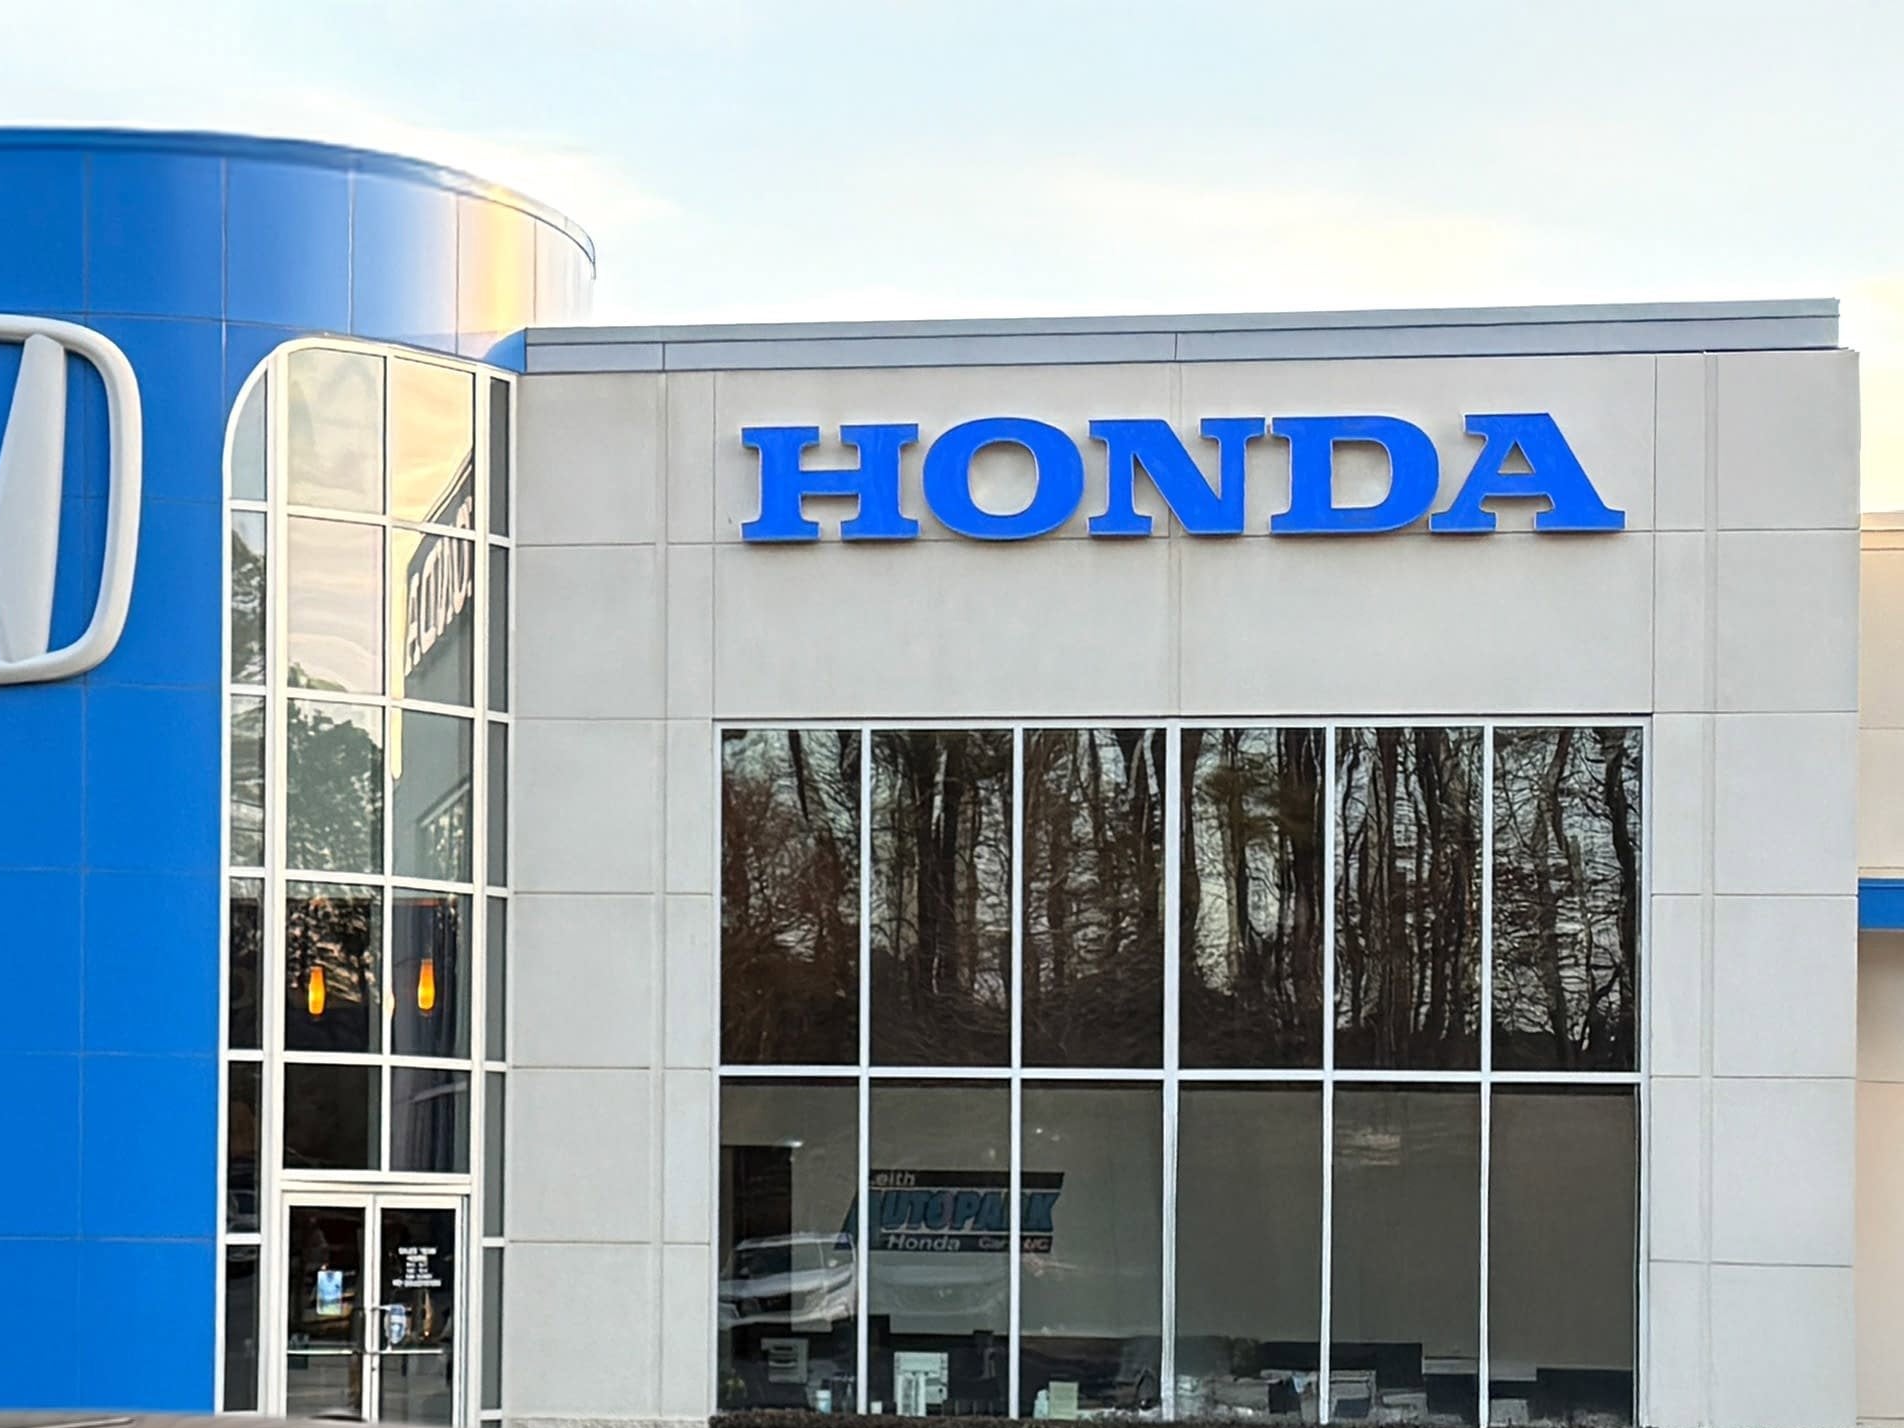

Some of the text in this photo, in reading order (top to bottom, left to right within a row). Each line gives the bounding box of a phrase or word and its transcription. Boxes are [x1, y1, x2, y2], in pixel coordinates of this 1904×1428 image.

[741, 412, 1626, 542] HONDA
[870, 1171, 916, 1187] eith
[887, 1234, 961, 1251] Honda
